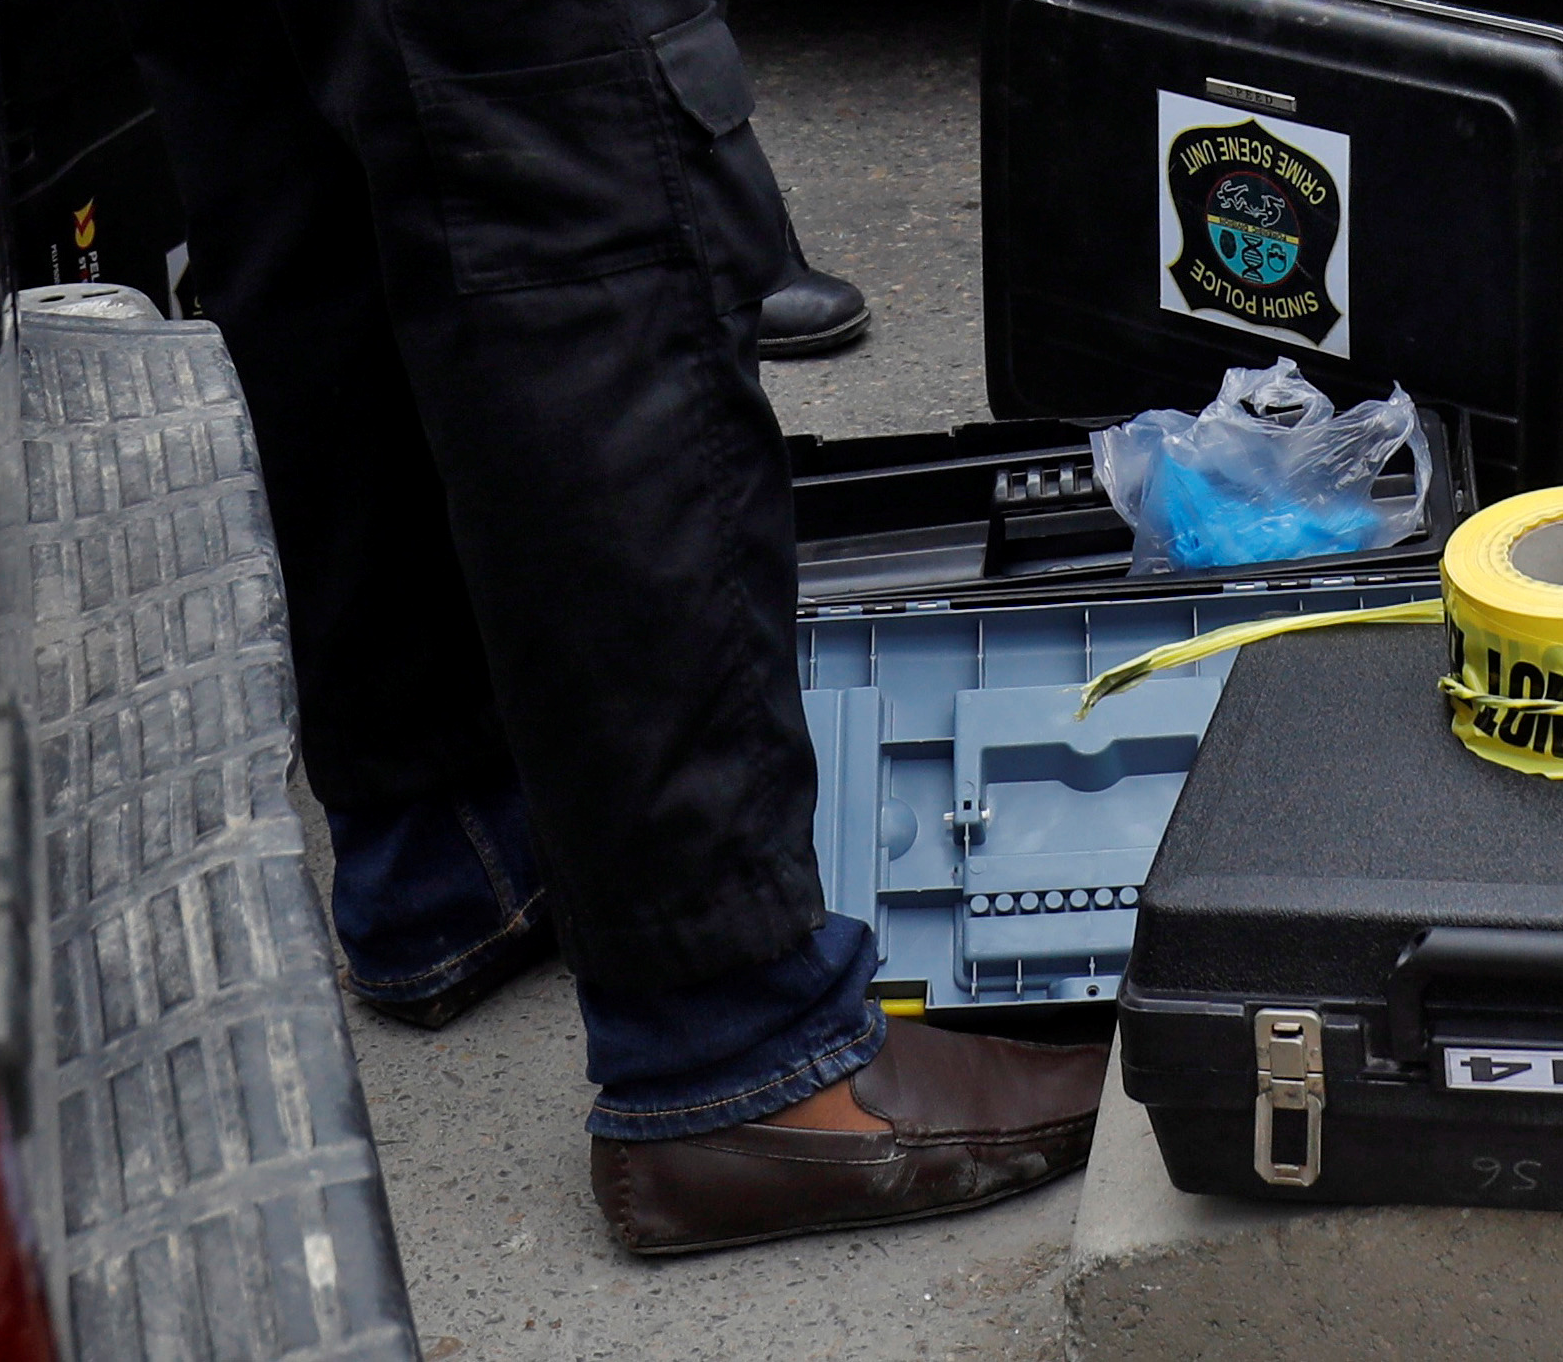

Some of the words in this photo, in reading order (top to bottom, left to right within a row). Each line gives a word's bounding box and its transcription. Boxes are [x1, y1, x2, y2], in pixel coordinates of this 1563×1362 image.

[1179, 138, 1217, 176] UNIT
[1219, 135, 1274, 169] SCENE
[1274, 151, 1328, 206] CRIME
[88, 250, 101, 283] PEL
[1189, 258, 1258, 316] POLICE
[1261, 290, 1320, 319] SINDH
